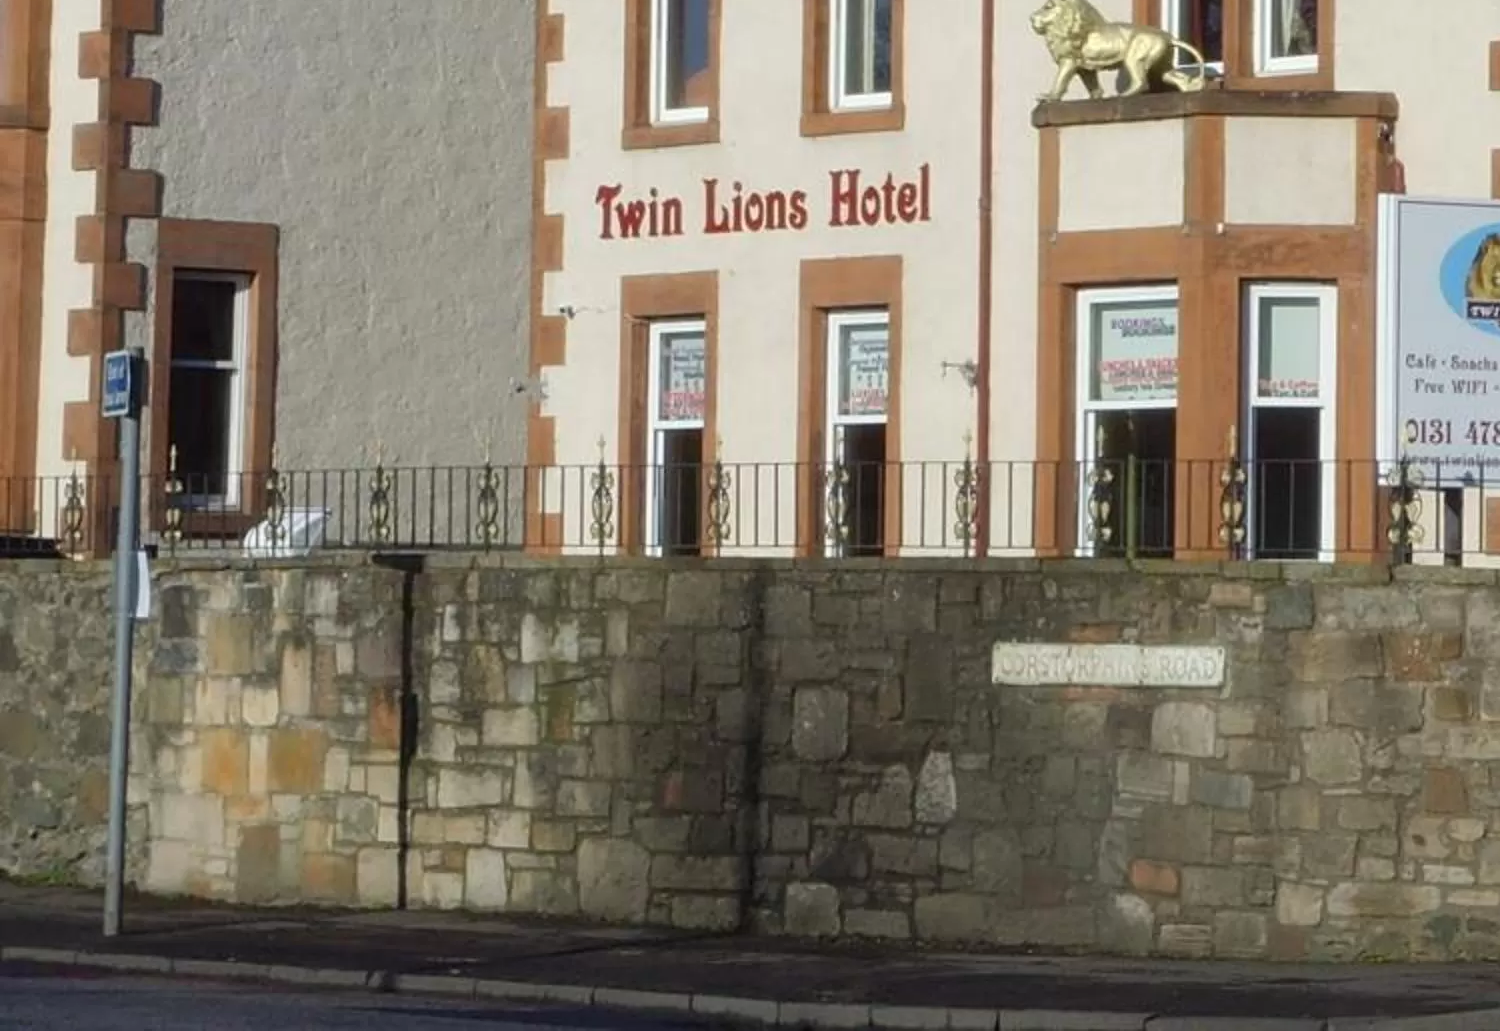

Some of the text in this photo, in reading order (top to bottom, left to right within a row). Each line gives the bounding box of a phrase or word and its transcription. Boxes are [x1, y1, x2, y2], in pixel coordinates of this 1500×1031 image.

[595, 162, 932, 239] Twin Lions Hotel
[1415, 378, 1445, 394] Free
[1404, 418, 1452, 445] 0131
[1159, 654, 1217, 681] ROAD
